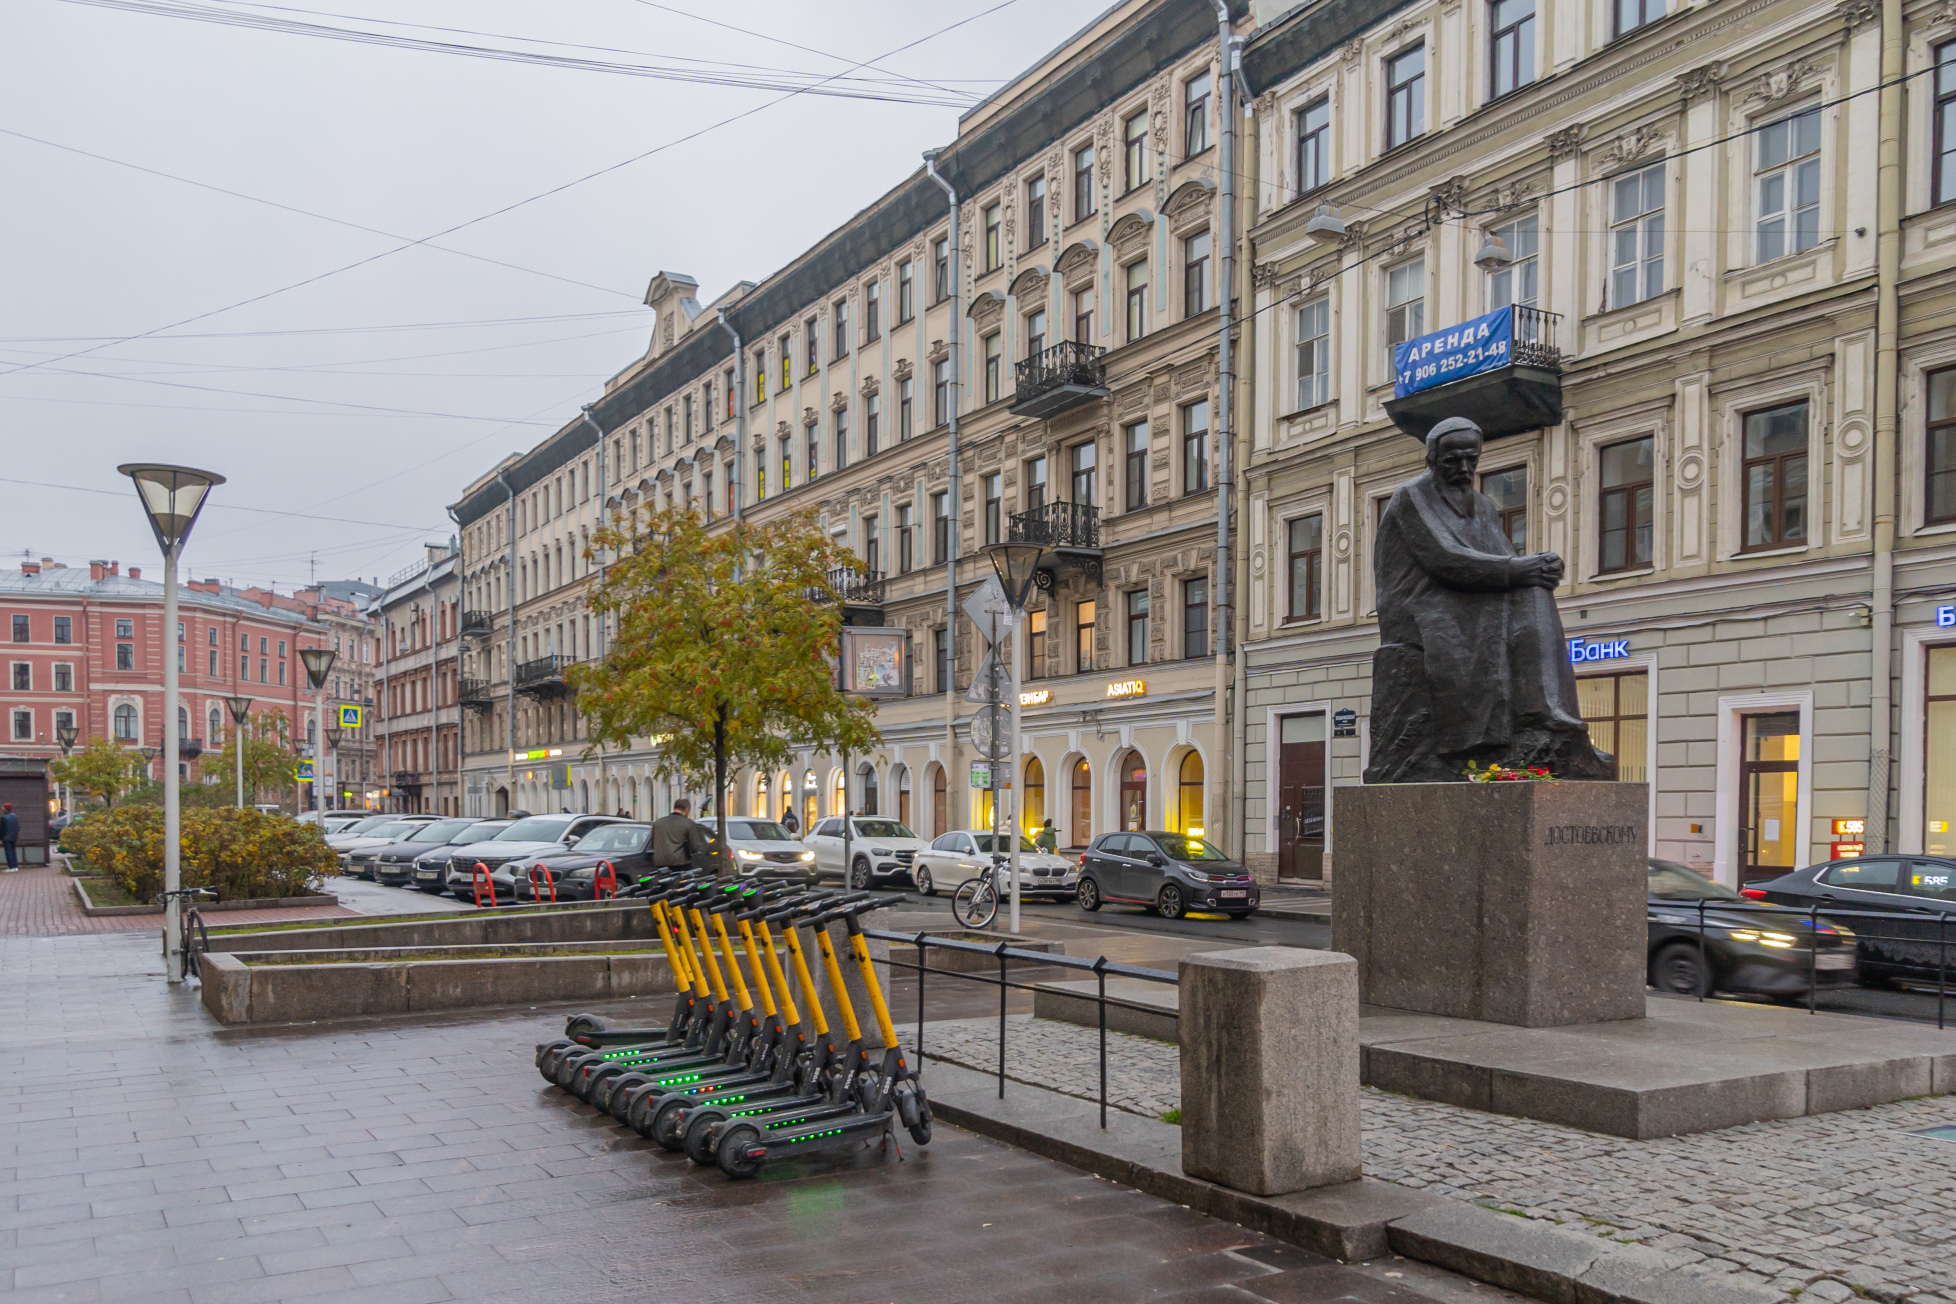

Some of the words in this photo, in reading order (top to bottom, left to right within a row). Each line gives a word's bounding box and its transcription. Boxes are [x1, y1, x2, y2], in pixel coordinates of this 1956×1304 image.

[1408, 322, 1490, 363] АРЕНДА
[1415, 362, 1437, 381] 906
[1440, 340, 1506, 373] 252-21-48
[1569, 638, 1630, 662] Банк
[1107, 680, 1146, 697] ASIATIQ
[1544, 825, 1637, 846] ДОСТОЕВСКОМУ
